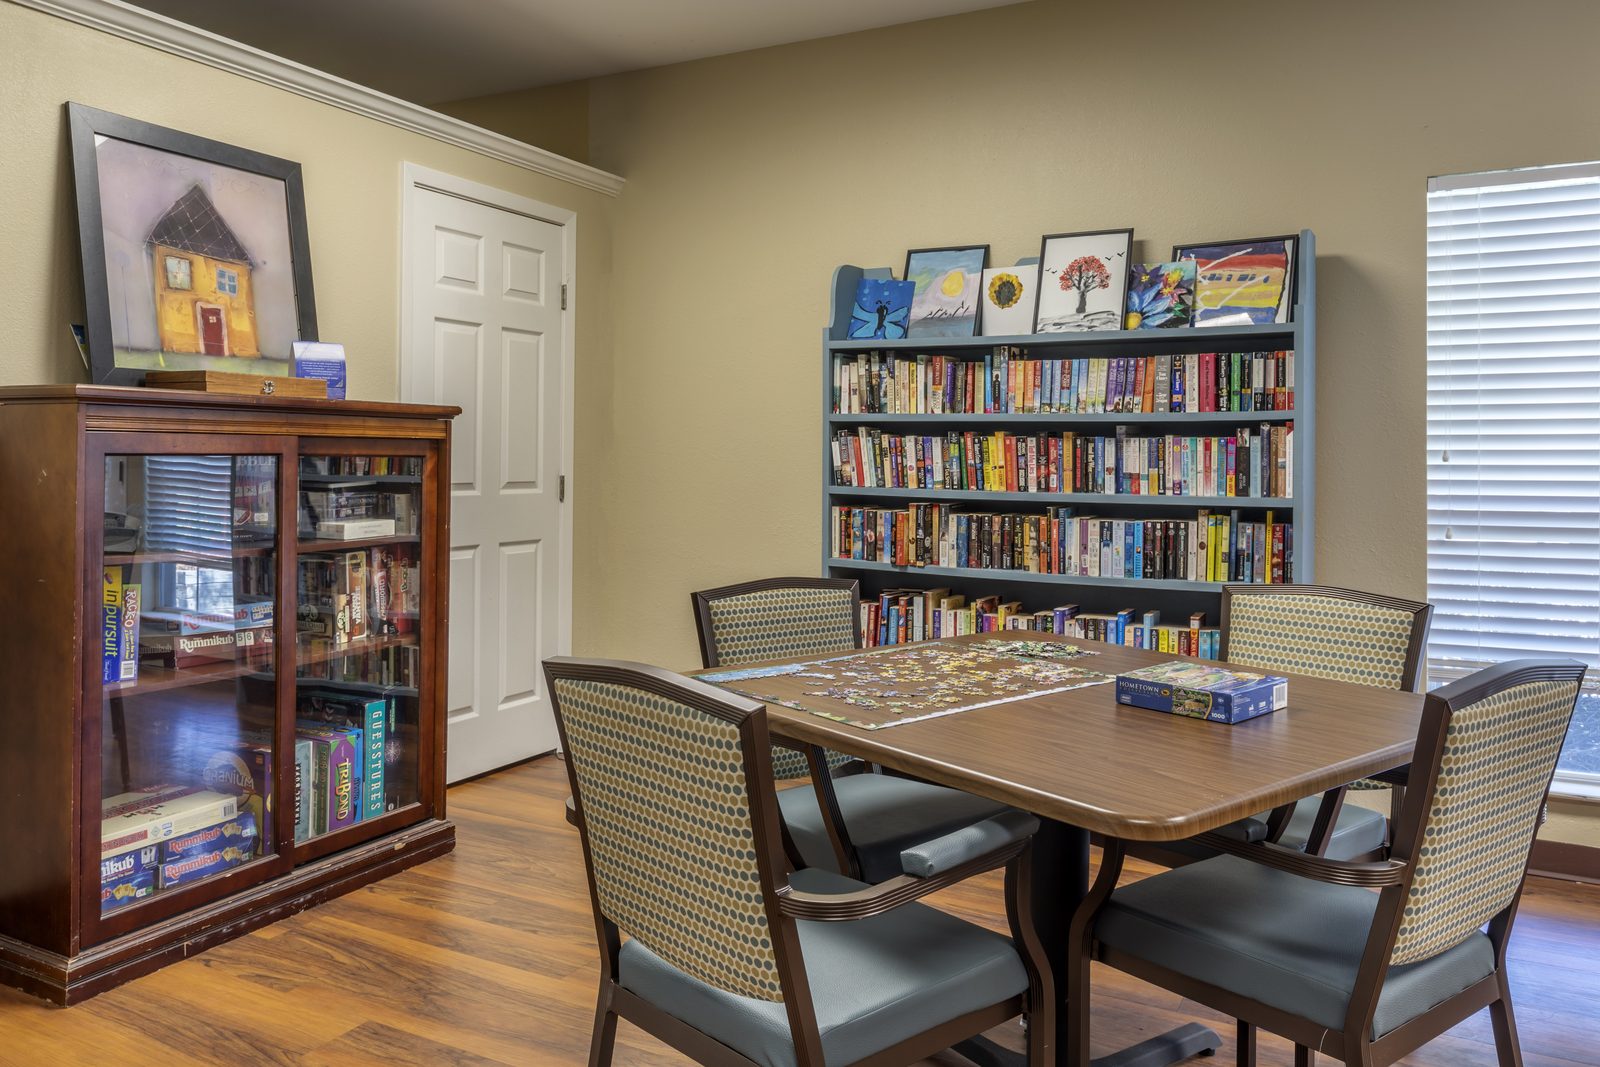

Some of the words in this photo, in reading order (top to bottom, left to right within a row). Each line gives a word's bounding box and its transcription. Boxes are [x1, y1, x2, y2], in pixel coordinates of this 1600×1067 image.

[179, 635, 234, 653] Rummikub
[1119, 681, 1160, 693] HOMETOWN
[370, 710, 383, 811] GUESSTURES
[169, 828, 222, 854] Rummikub
[165, 851, 222, 880] Rummikub
